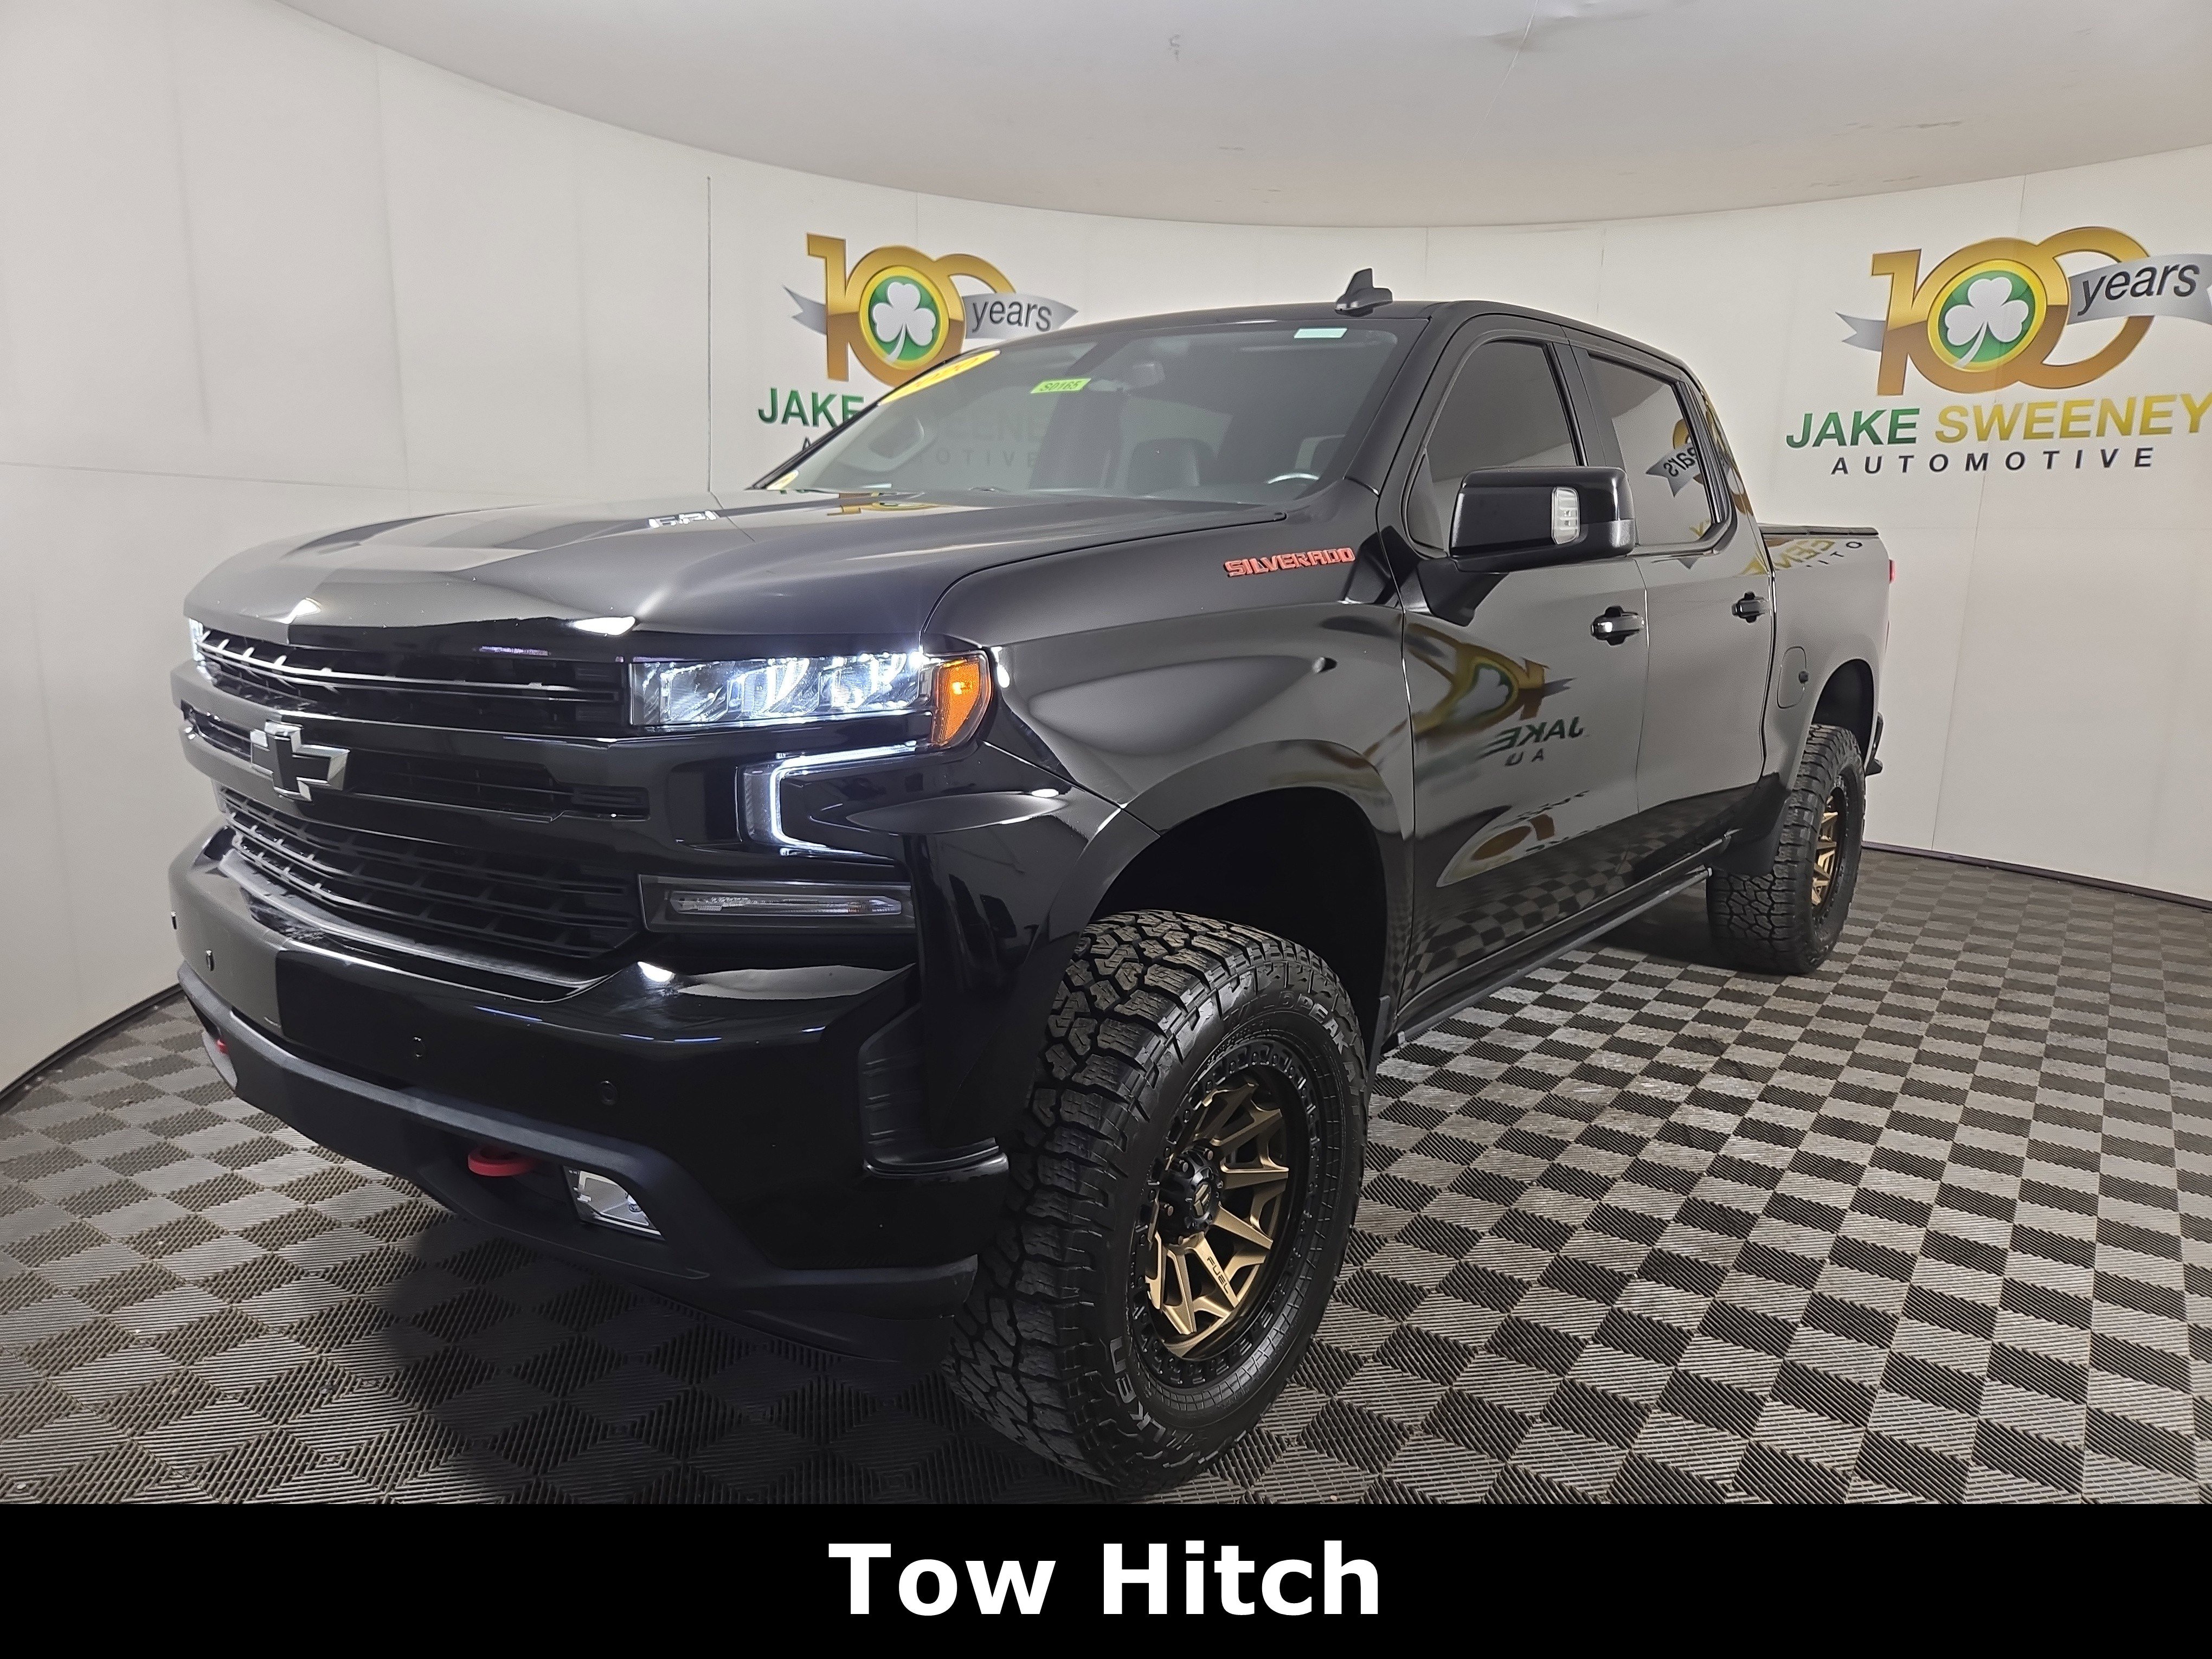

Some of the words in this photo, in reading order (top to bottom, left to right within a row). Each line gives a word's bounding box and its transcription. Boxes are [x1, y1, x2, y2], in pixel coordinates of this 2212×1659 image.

[2077, 263, 2200, 316] years
[971, 294, 1052, 332] years
[758, 387, 865, 428] JAKE
[1786, 408, 1920, 449] JAKE
[1935, 393, 2212, 443] SWEENEY
[1831, 447, 2155, 475] AUTOMOTIVE
[1224, 547, 1356, 577] SILVERADO
[1206, 1256, 1229, 1294] FUEL
